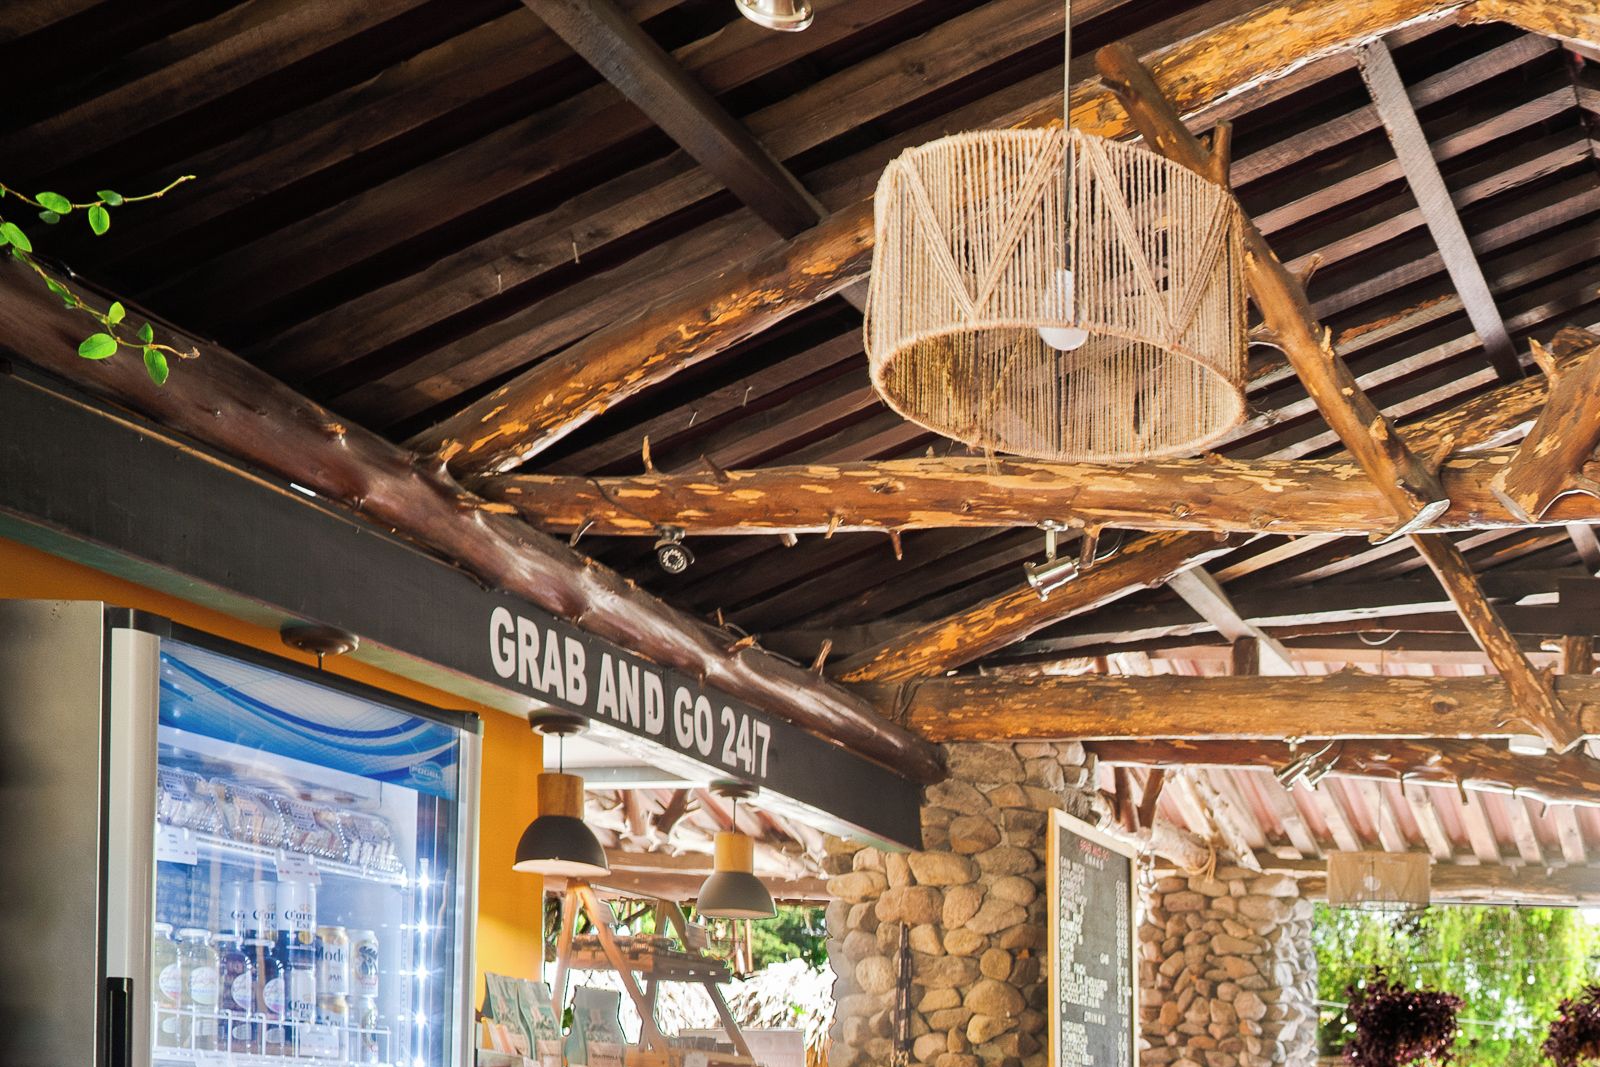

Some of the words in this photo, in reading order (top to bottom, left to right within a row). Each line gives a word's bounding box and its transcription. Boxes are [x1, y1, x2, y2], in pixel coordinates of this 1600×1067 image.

[489, 606, 588, 706] GRAB
[596, 652, 664, 736] AND
[673, 686, 714, 757] GO
[720, 705, 771, 779] 24/7
